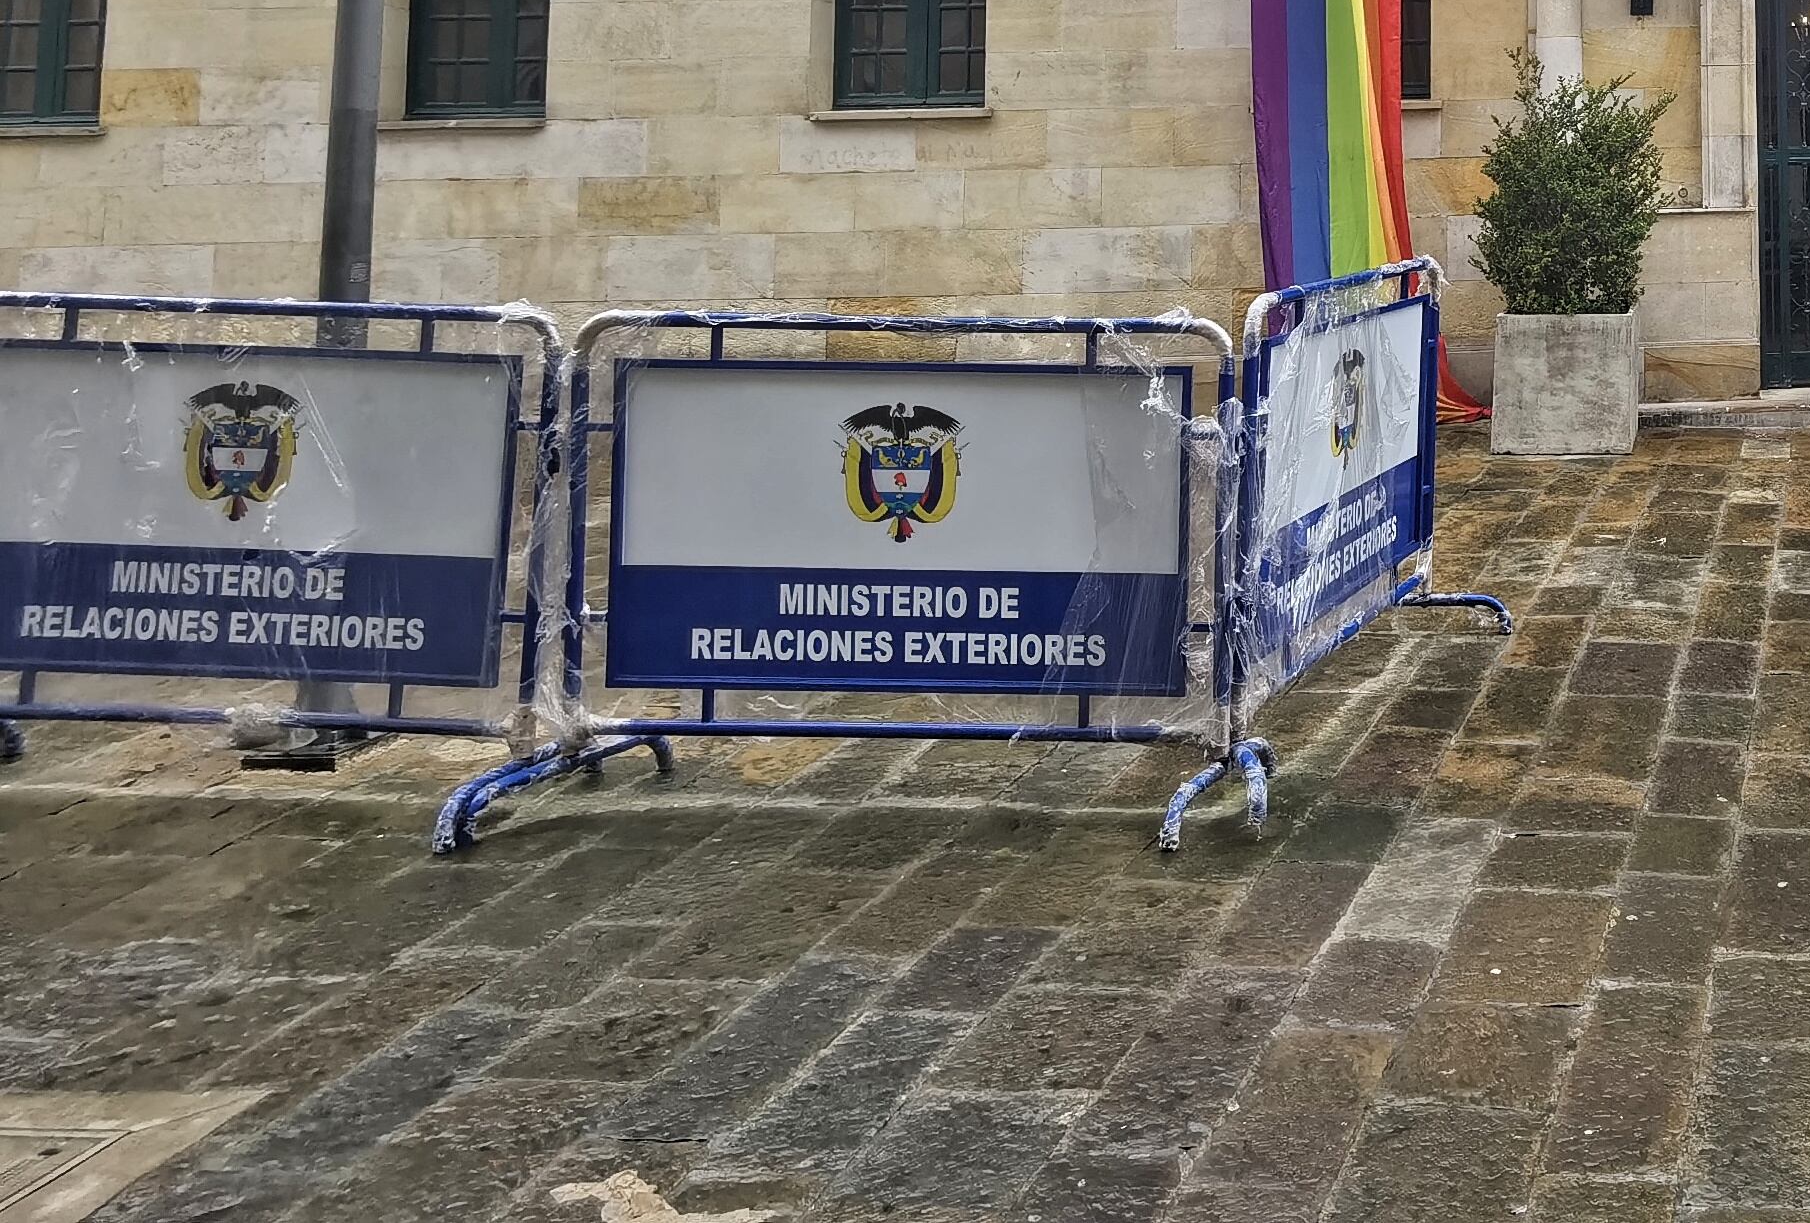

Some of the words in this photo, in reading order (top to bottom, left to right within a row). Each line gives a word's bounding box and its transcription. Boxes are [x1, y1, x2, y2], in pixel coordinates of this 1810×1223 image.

[1306, 498, 1363, 557] MTERIO
[1343, 515, 1398, 575] EXTERIORES
[110, 560, 295, 599] MINISTERIO
[304, 567, 346, 601] DE
[778, 583, 968, 618] MINISTERIO
[978, 586, 1020, 619] DE
[20, 604, 220, 644] RELACIONES
[228, 611, 426, 651] EXTERIORES
[690, 627, 894, 664] RELACIONES
[903, 631, 1107, 667] EXTERIORES
